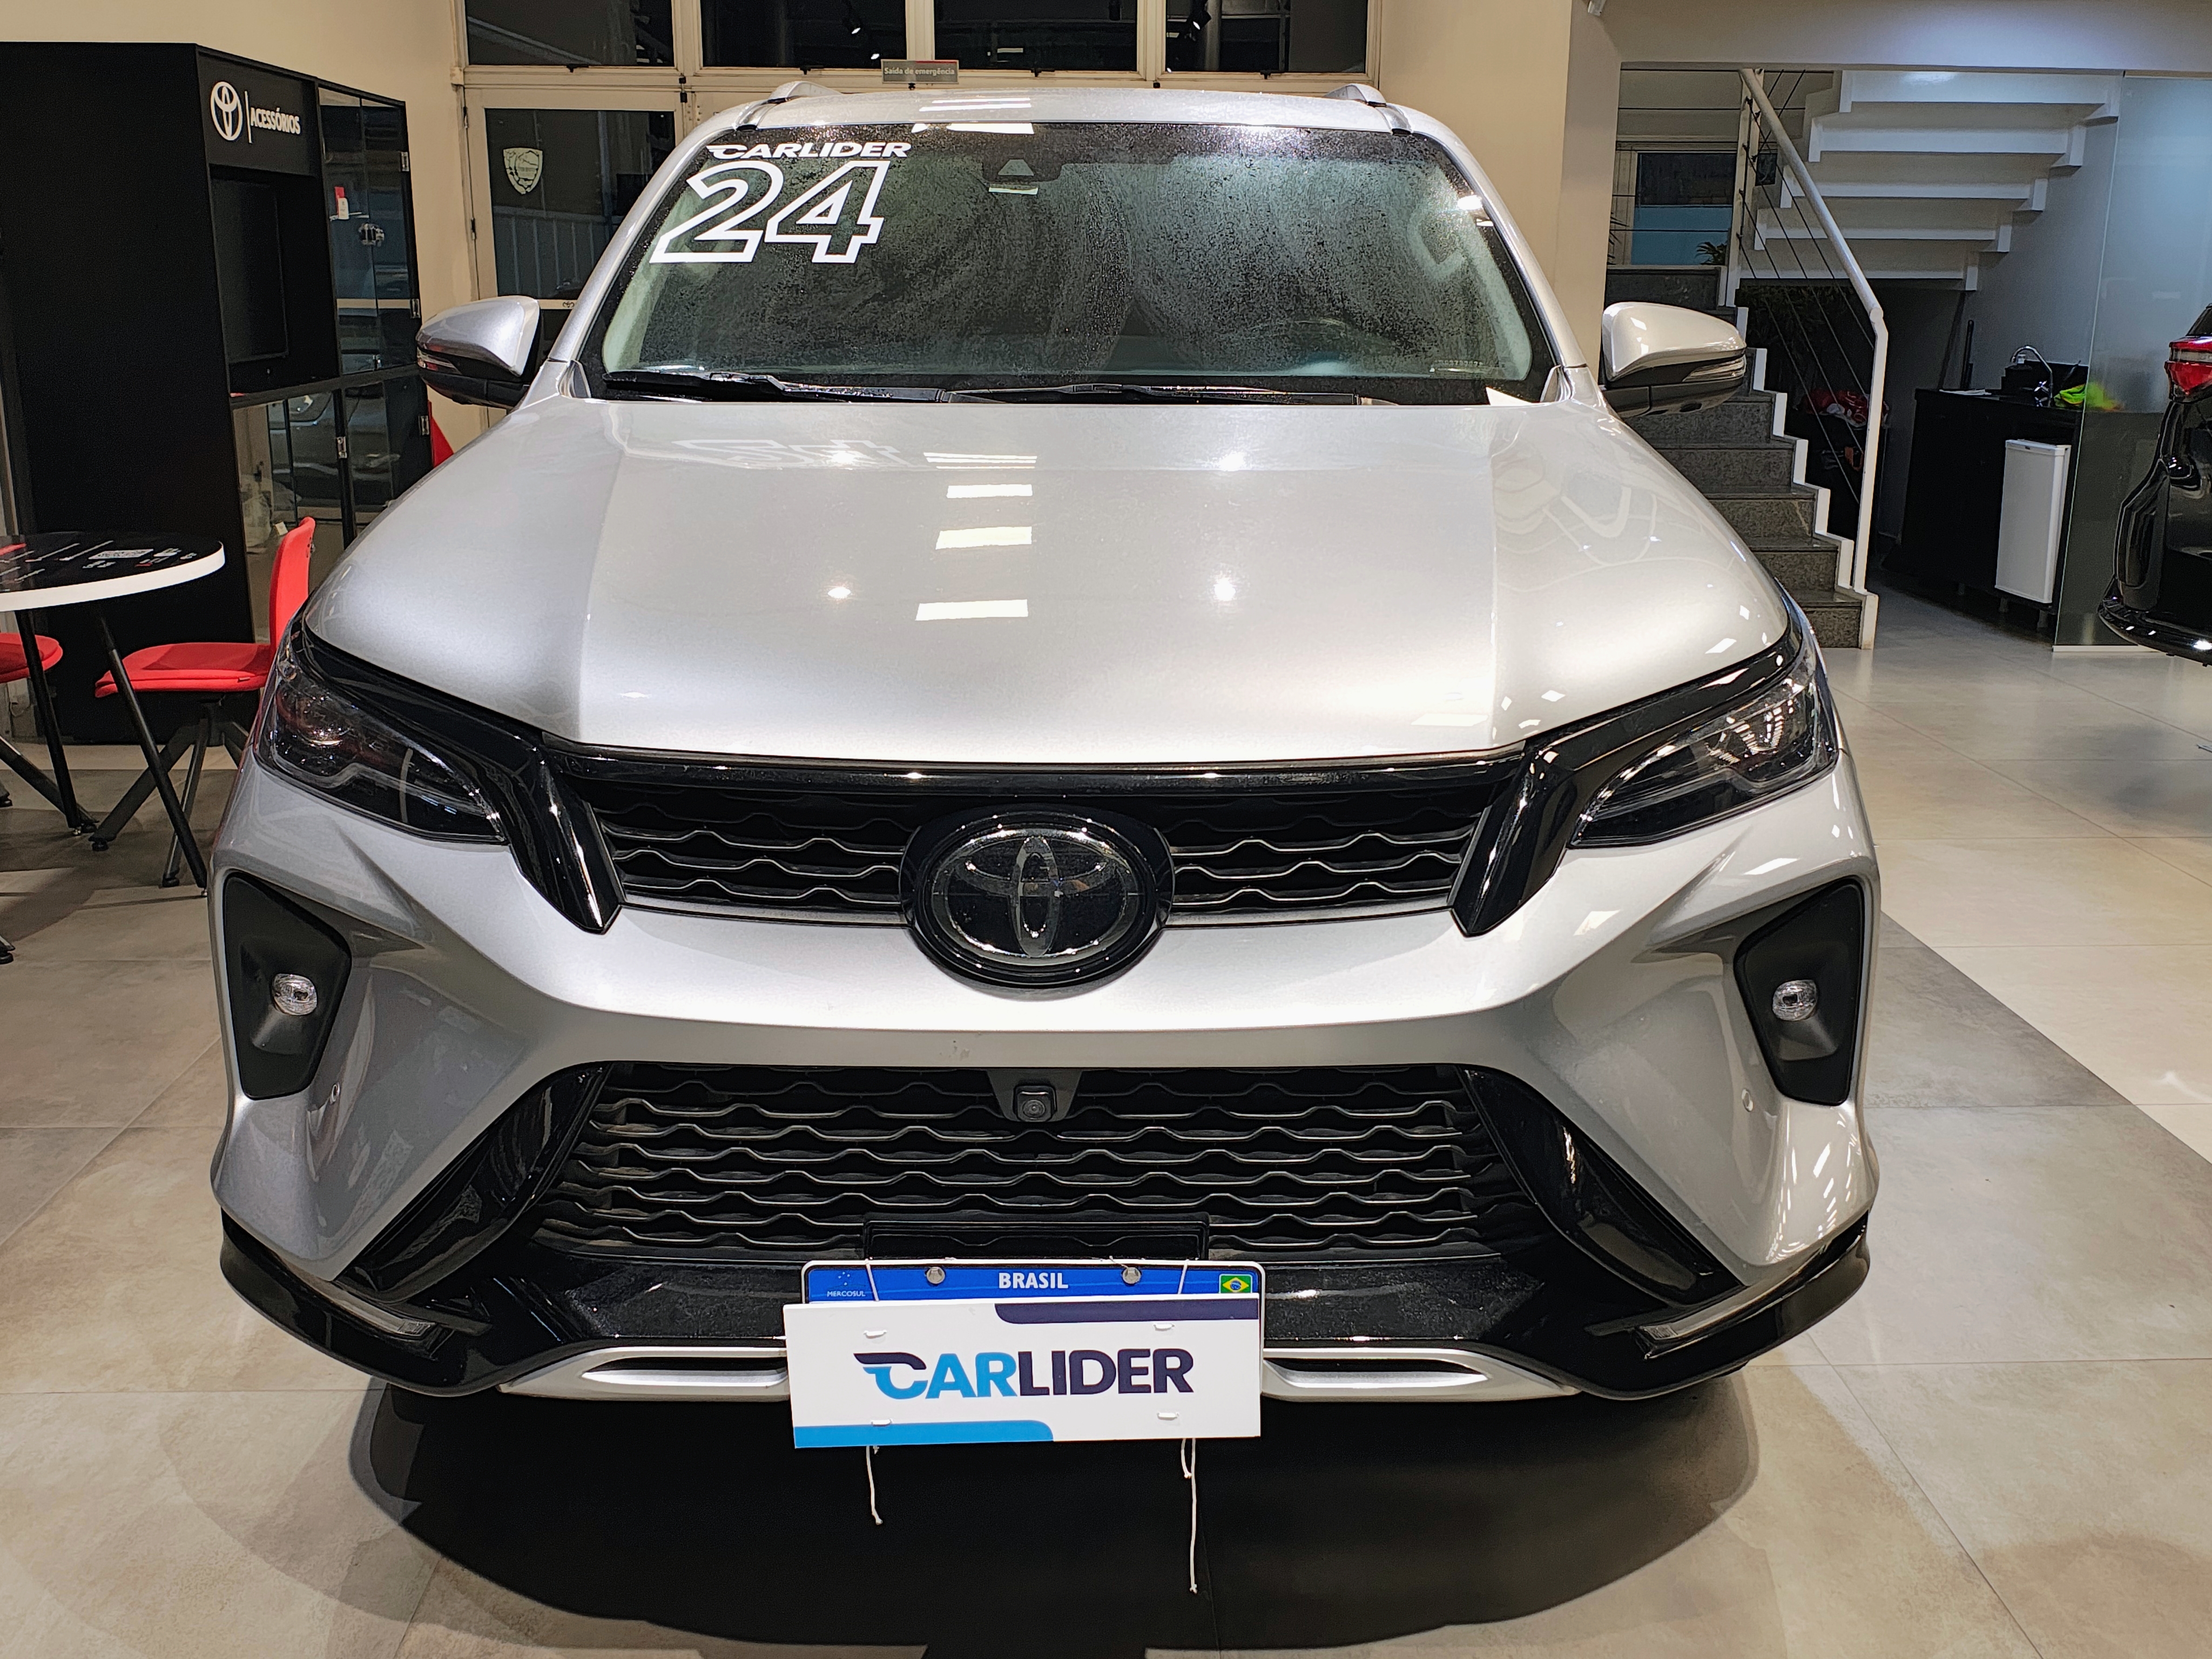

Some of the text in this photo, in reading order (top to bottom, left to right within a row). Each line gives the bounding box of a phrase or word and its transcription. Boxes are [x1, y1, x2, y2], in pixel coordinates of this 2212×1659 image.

[915, 68, 955, 76] emergência
[251, 107, 301, 134] ACESSÓRIOS
[706, 142, 912, 159] CARLIDER
[649, 160, 891, 263] 24
[999, 1272, 1069, 1289] BRASIL
[853, 1348, 1194, 1399] CARLIDER
